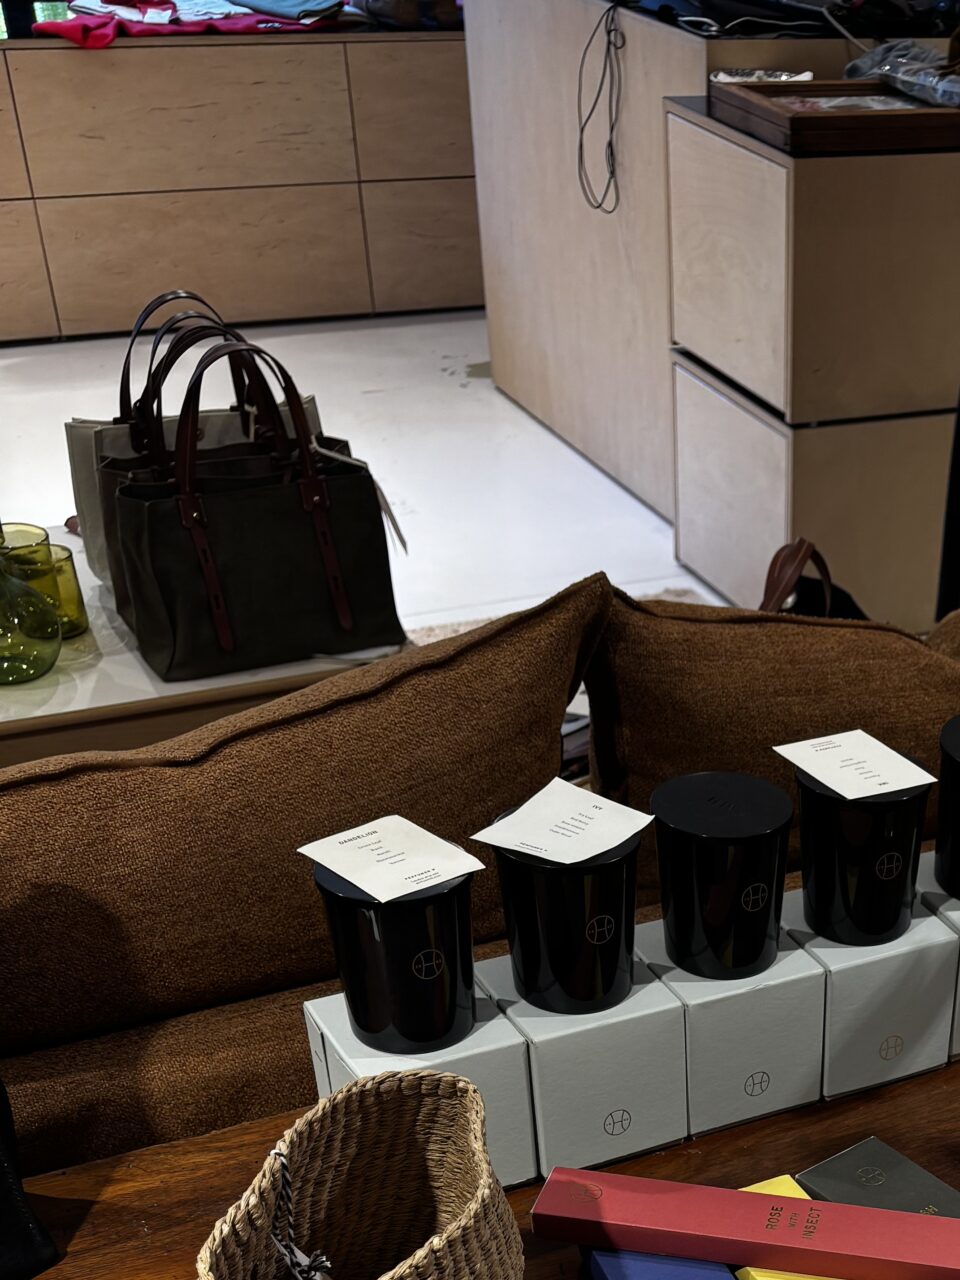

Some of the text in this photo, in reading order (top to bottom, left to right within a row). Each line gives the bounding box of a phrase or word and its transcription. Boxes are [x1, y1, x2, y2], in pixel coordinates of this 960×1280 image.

[338, 830, 378, 845] DANDELION
[765, 1206, 784, 1231] ROSE
[788, 1212, 799, 1228] WITH
[802, 1206, 822, 1240] INSECT
